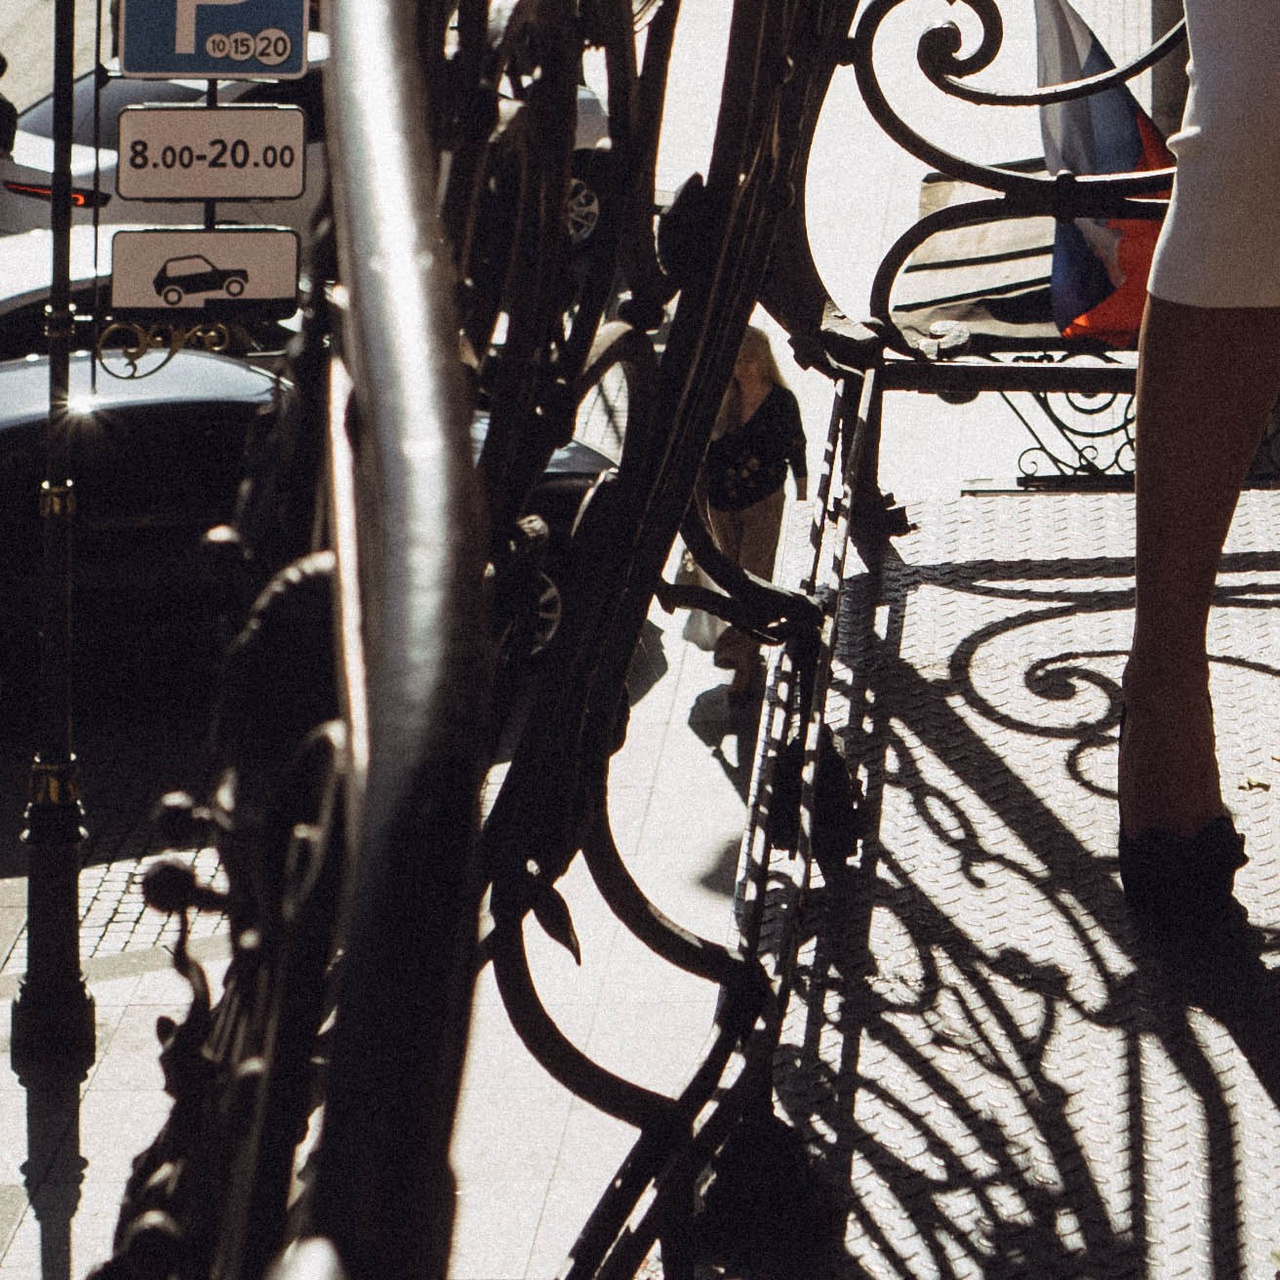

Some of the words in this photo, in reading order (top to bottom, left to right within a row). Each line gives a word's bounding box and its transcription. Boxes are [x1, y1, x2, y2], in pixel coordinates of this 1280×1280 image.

[211, 40, 226, 53] 10
[233, 38, 250, 55] 15
[258, 36, 288, 57] 20
[129, 139, 295, 169] 8.00-20.00
